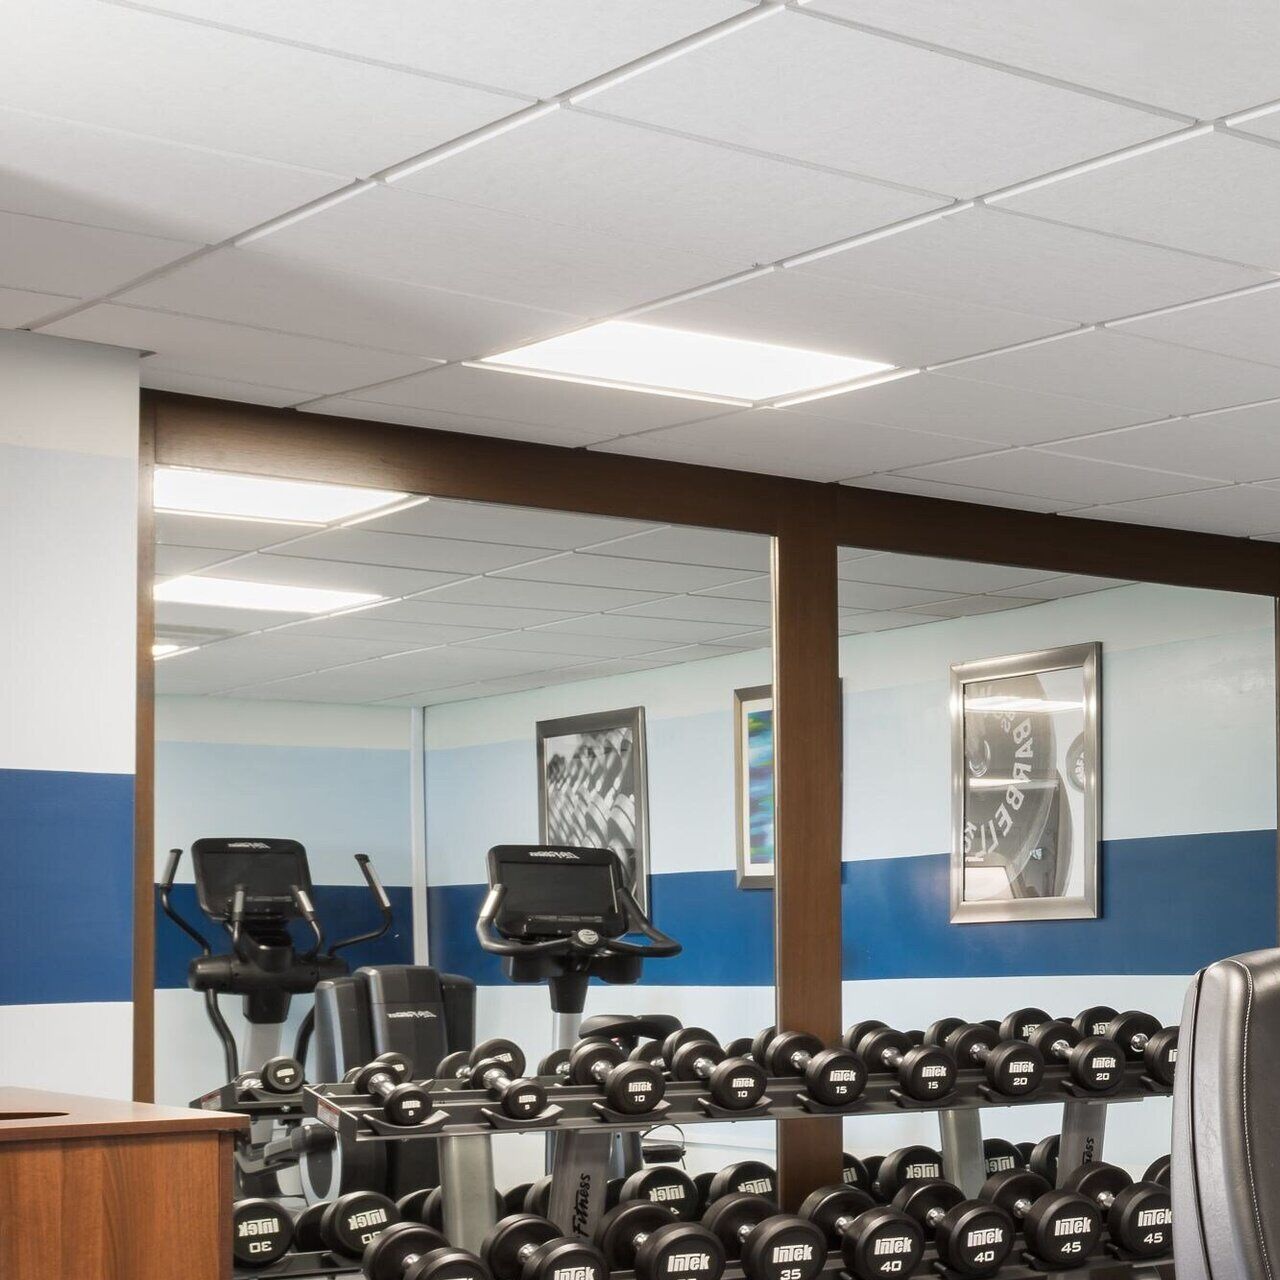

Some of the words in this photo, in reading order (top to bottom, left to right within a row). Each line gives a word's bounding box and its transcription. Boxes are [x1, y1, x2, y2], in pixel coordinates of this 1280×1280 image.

[1008, 1061, 1034, 1074] InTek
[1092, 1057, 1116, 1069] InTek
[829, 1069, 856, 1082] InTek
[921, 1065, 947, 1078] InTek
[1096, 1072, 1110, 1081] 20
[927, 1081, 938, 1089] 15
[1013, 1077, 1028, 1086] 20
[835, 1086, 848, 1094] 15
[1054, 1217, 1092, 1236] InTek
[967, 1228, 1003, 1247] InTek
[1143, 1232, 1164, 1244] 45
[874, 1237, 913, 1255] InTek
[1061, 1241, 1082, 1254] 45
[772, 1245, 813, 1263] InTek
[973, 1251, 994, 1263] 40
[667, 1253, 710, 1272] InTek
[880, 1260, 902, 1272] 40
[780, 1269, 801, 1280] 35
